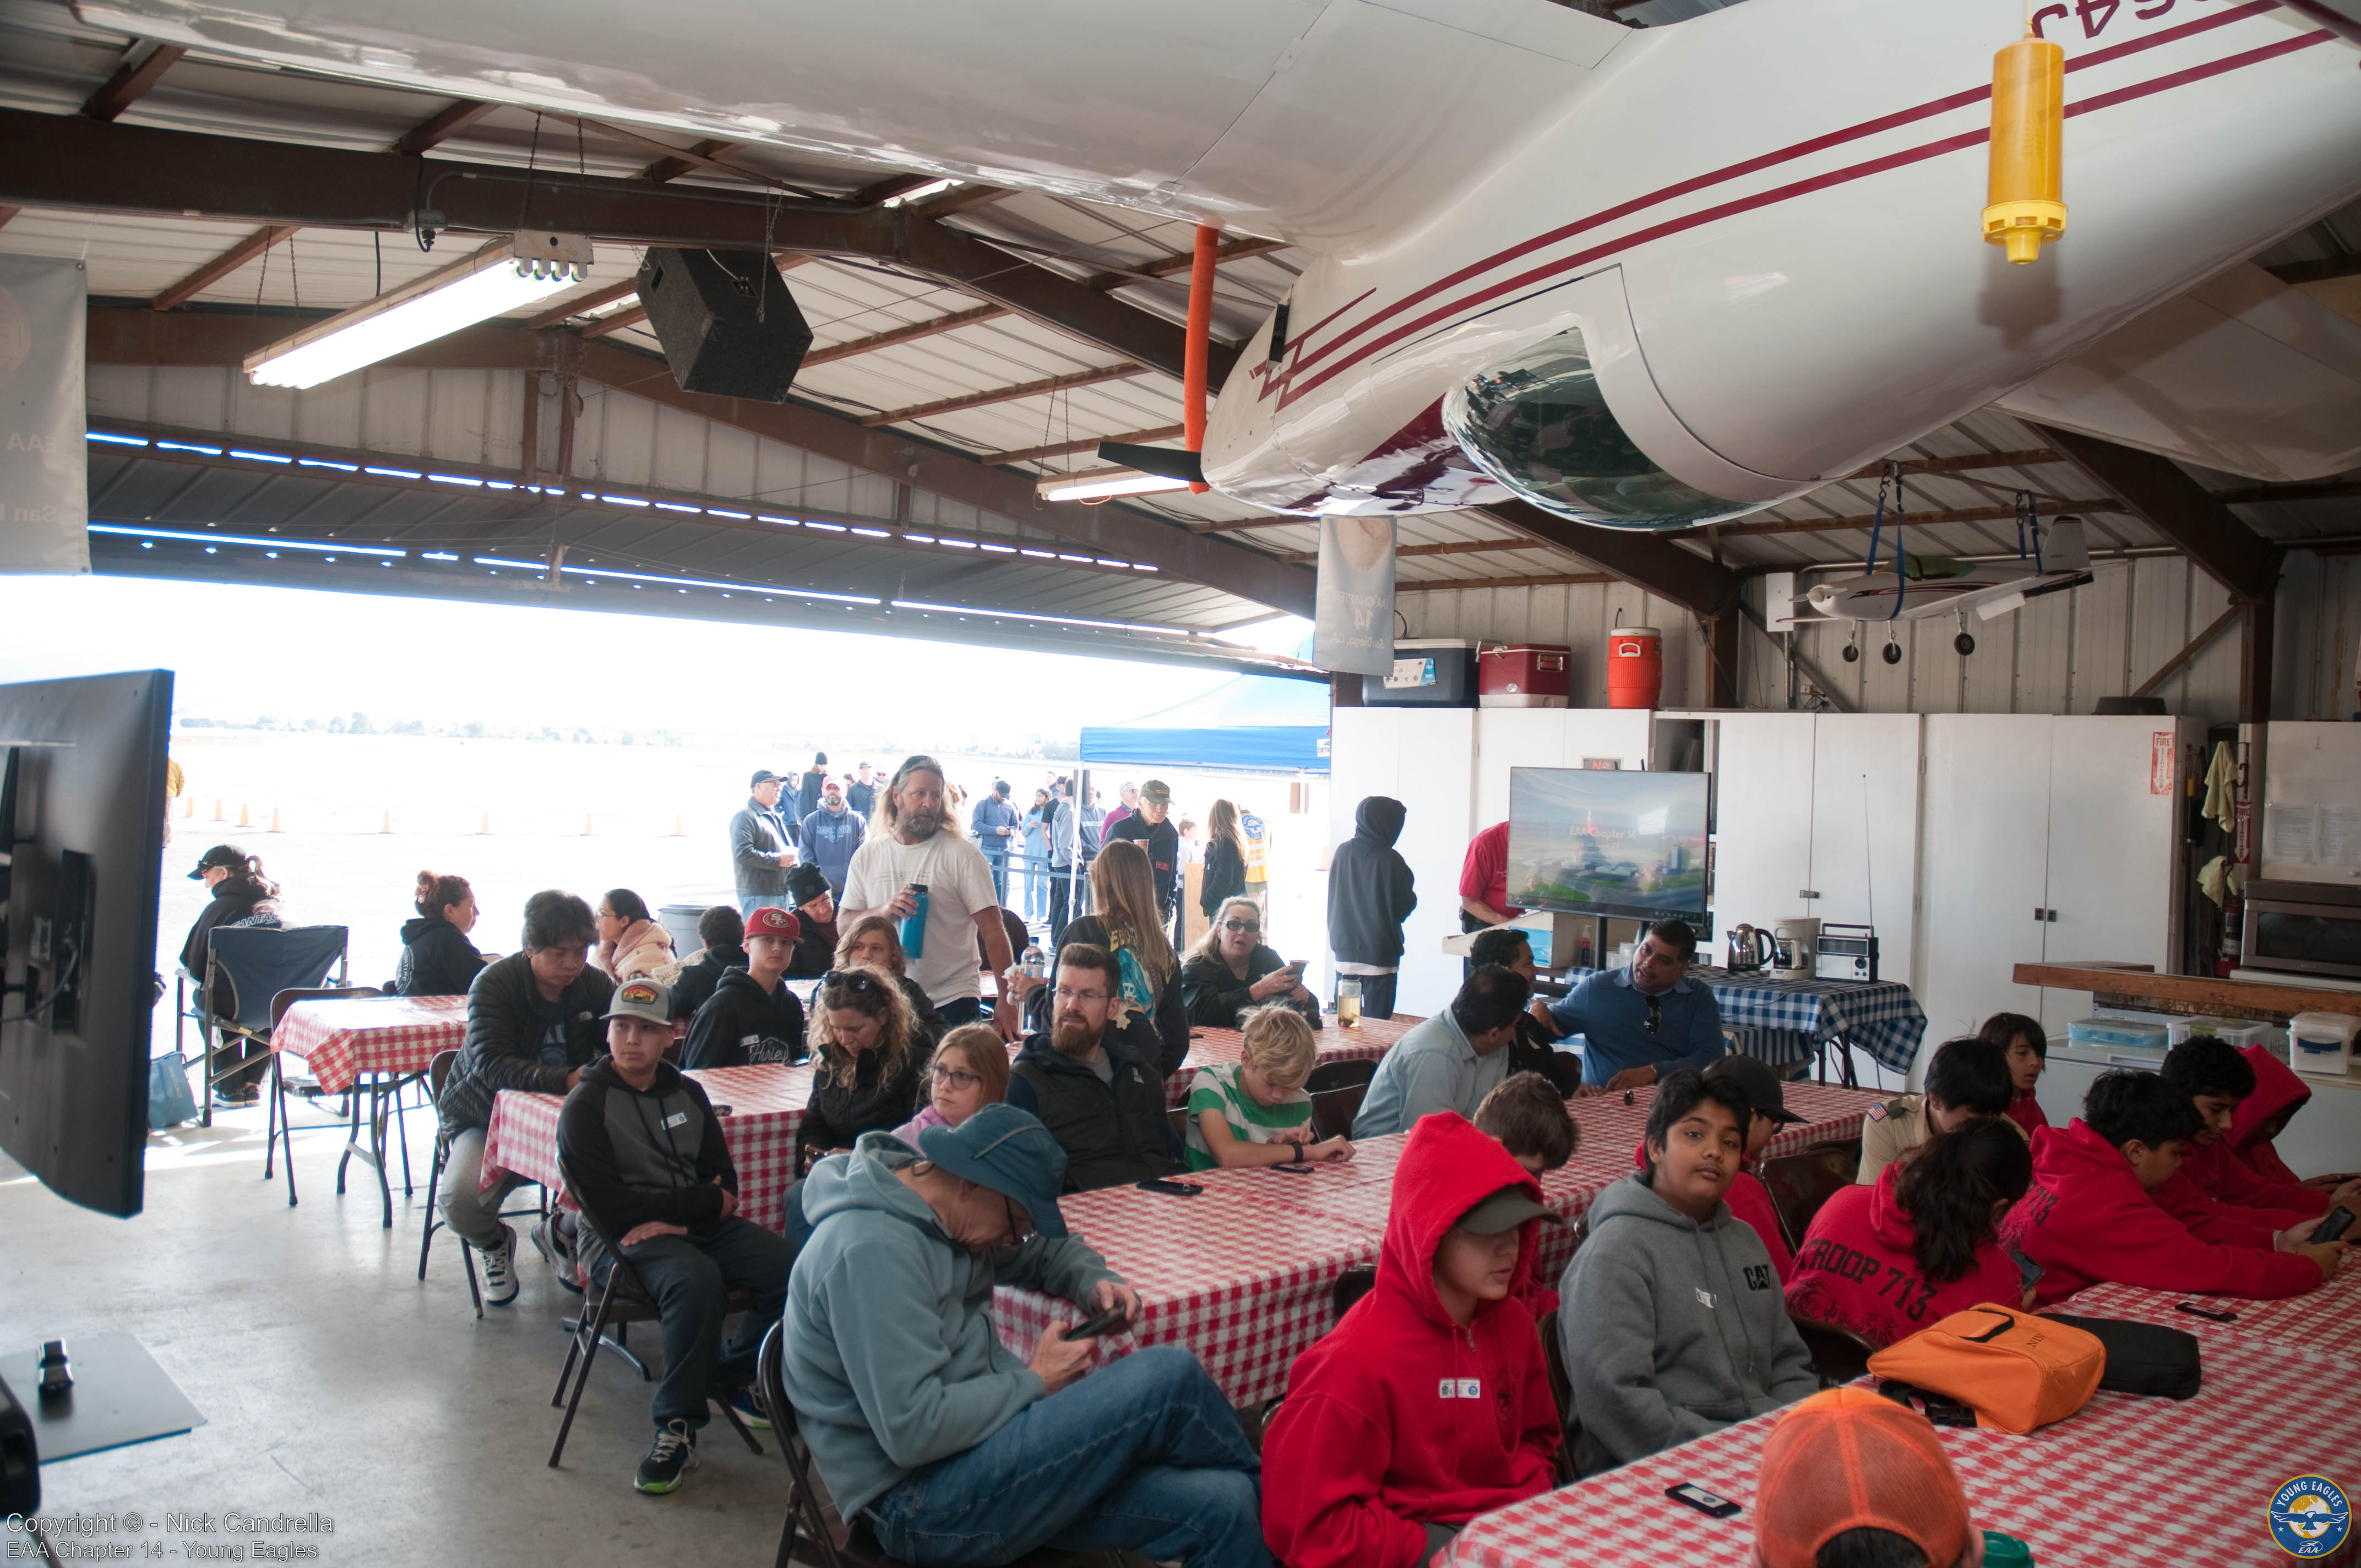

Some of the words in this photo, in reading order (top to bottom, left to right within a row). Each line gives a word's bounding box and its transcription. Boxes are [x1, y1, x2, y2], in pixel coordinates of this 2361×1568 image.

[2156, 738, 2170, 746] FIRE
[749, 1044, 789, 1063] Hurley
[2030, 1186, 2058, 1226] 713
[1744, 1266, 1770, 1290] CAT
[1799, 1238, 1880, 1284] TROOP
[1879, 1267, 1938, 1322] 713
